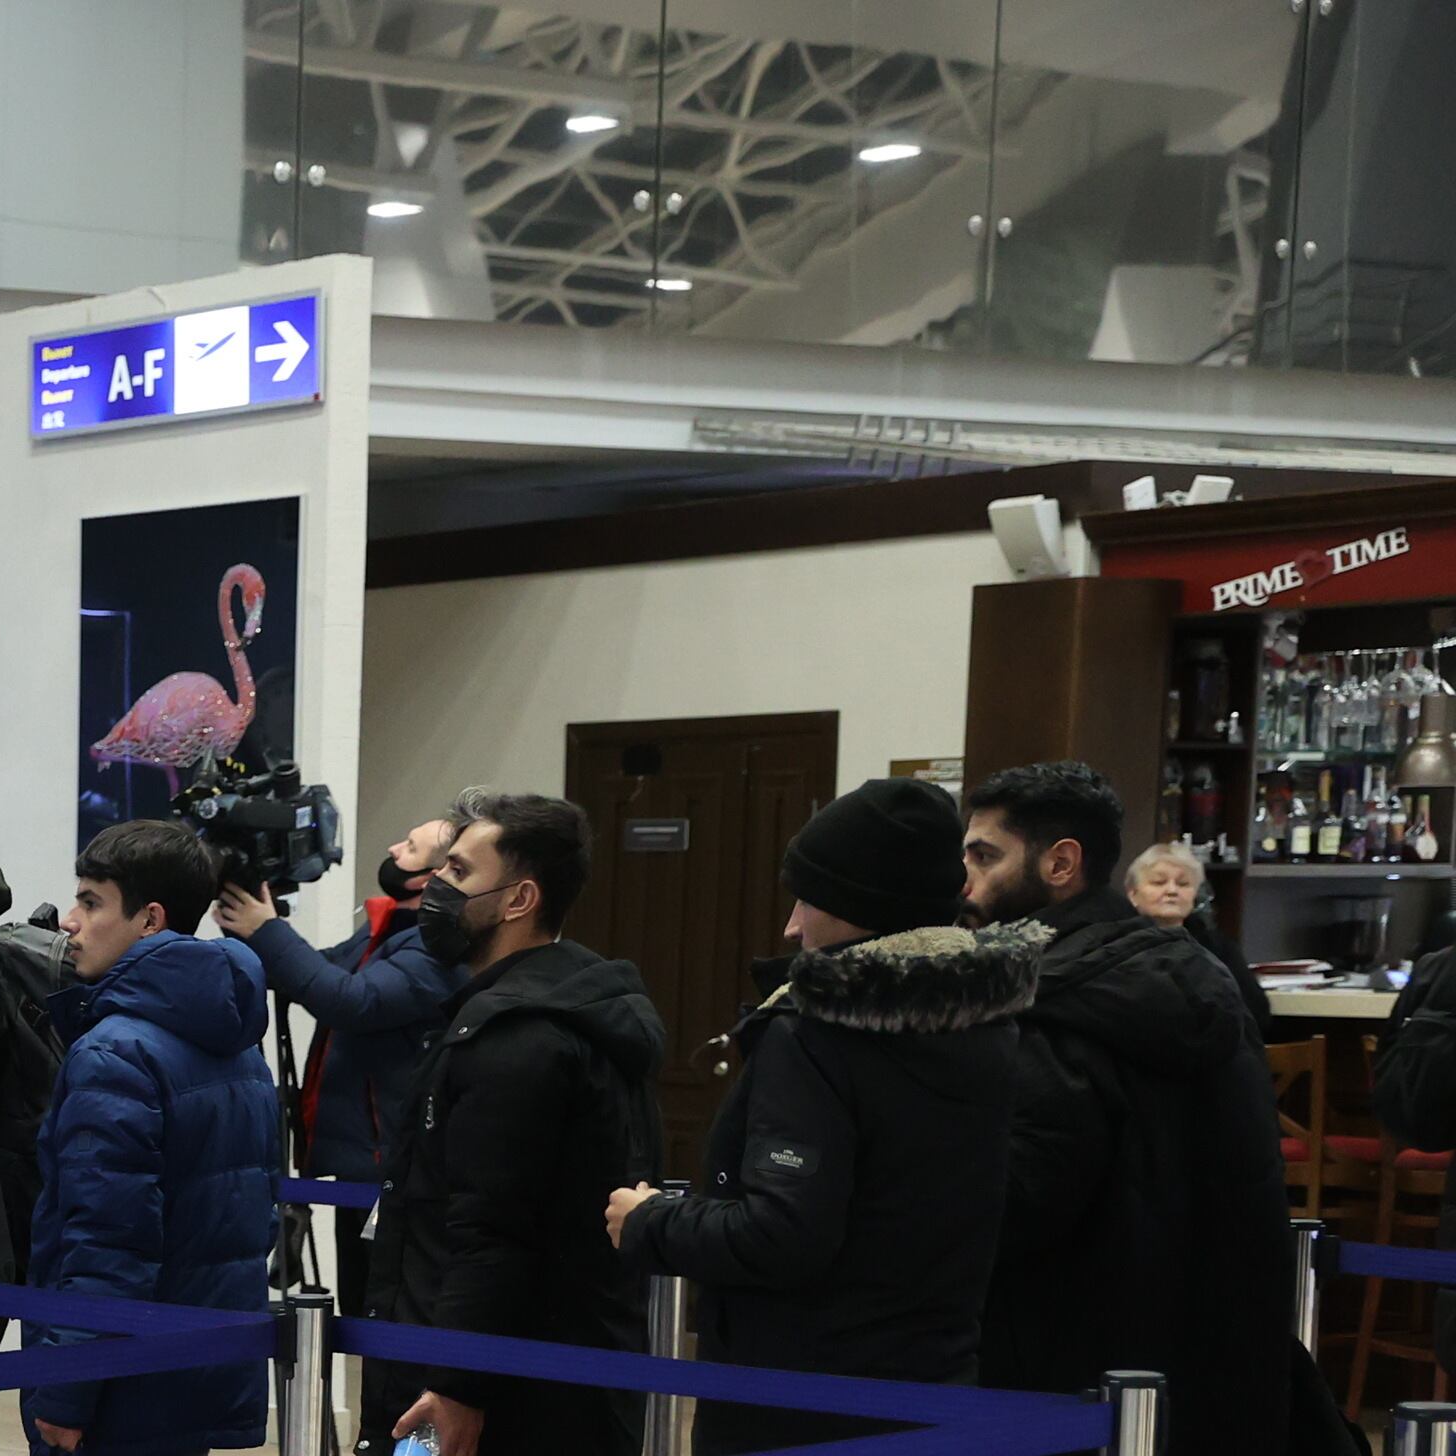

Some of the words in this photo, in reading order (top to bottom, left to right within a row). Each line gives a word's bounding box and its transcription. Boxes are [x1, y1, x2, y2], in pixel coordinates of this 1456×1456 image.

[108, 348, 166, 402] A-F
[1210, 561, 1304, 611] PRIME
[1325, 527, 1410, 575] TIME
